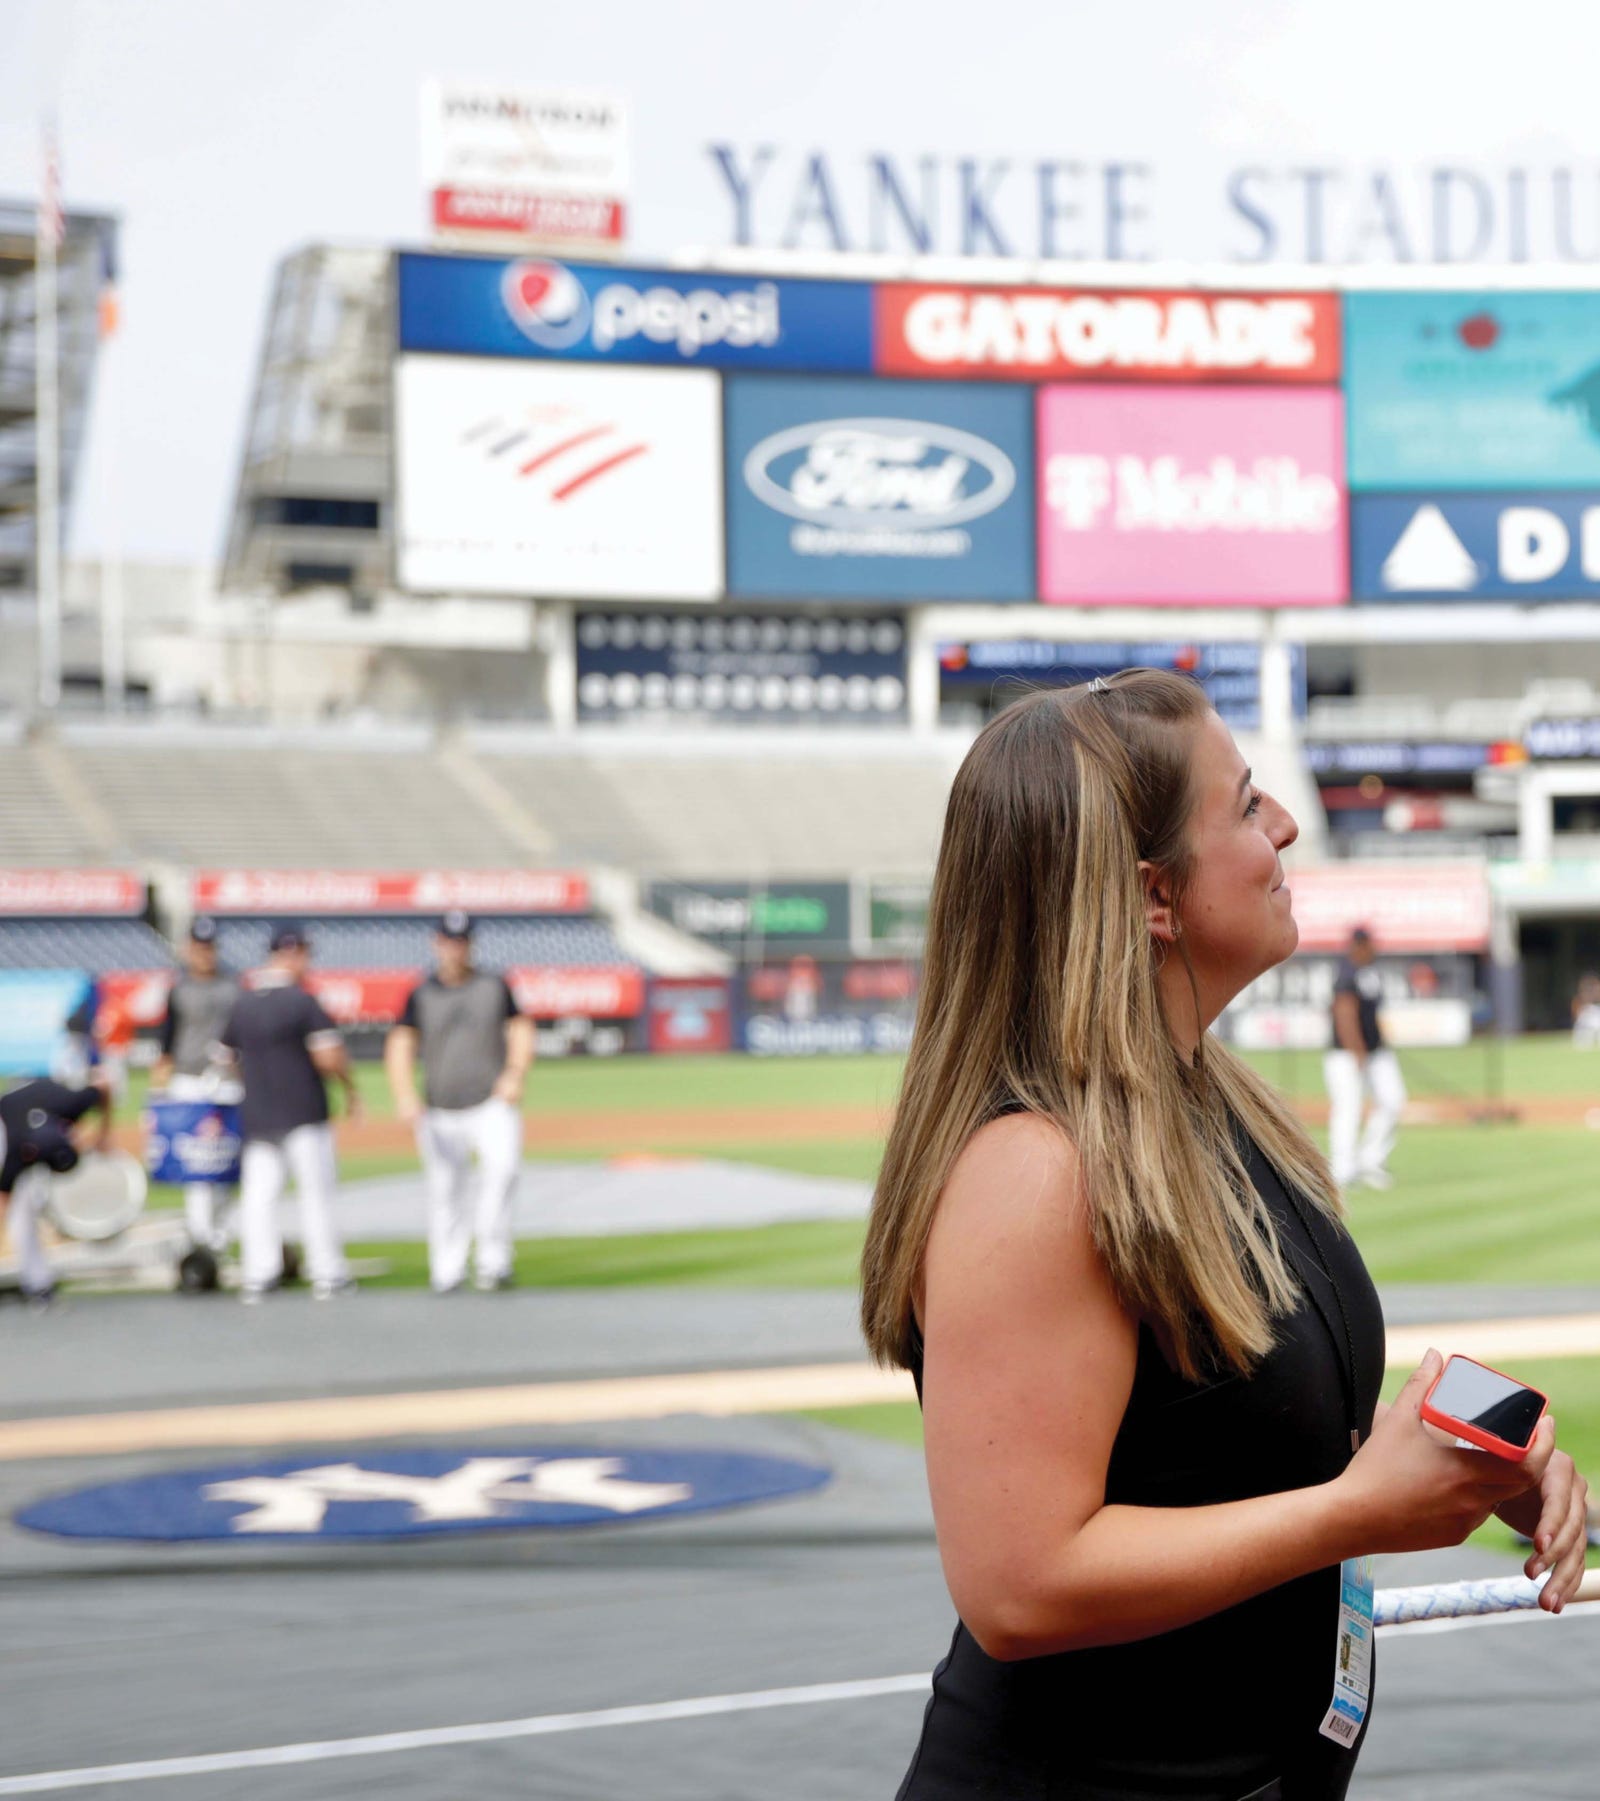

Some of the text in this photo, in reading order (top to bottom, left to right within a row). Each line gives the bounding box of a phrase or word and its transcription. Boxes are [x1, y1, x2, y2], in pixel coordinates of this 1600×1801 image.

[706, 142, 1156, 260] YANKEE
[592, 281, 779, 356] pepsi
[903, 291, 1314, 368] GATORADE
[790, 428, 969, 514] Ford
